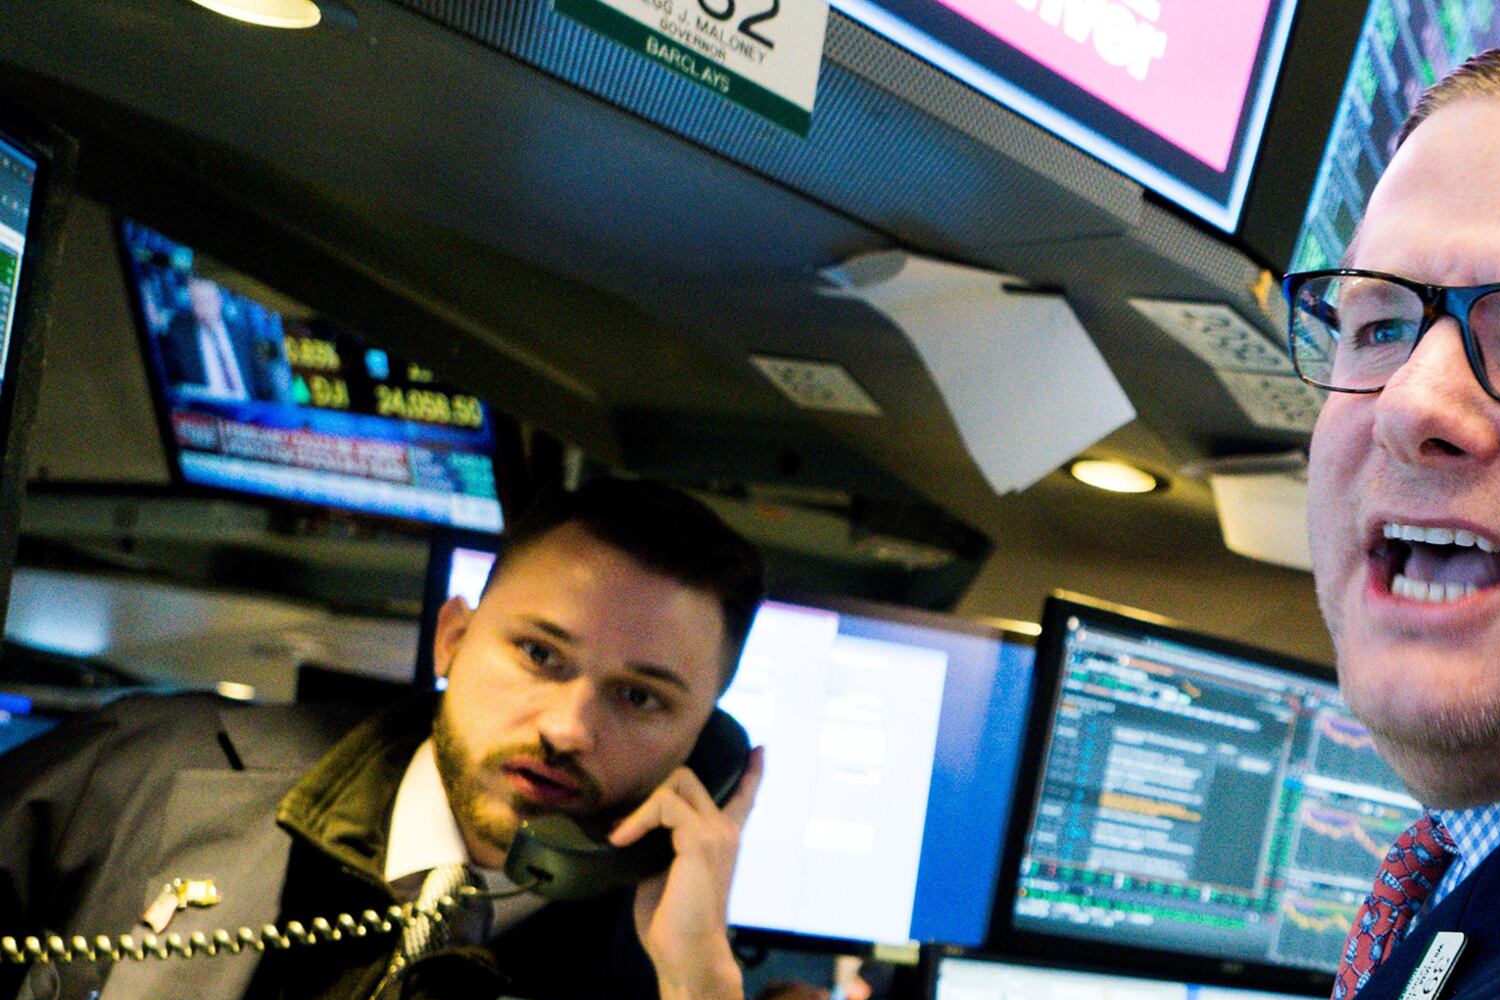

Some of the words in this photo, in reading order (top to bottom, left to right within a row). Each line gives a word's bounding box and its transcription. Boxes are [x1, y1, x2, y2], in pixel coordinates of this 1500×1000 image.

[660, 18, 727, 62] GOVERNOR
[696, 17, 767, 64] MALONEY
[645, 35, 731, 94] BARCLAYS
